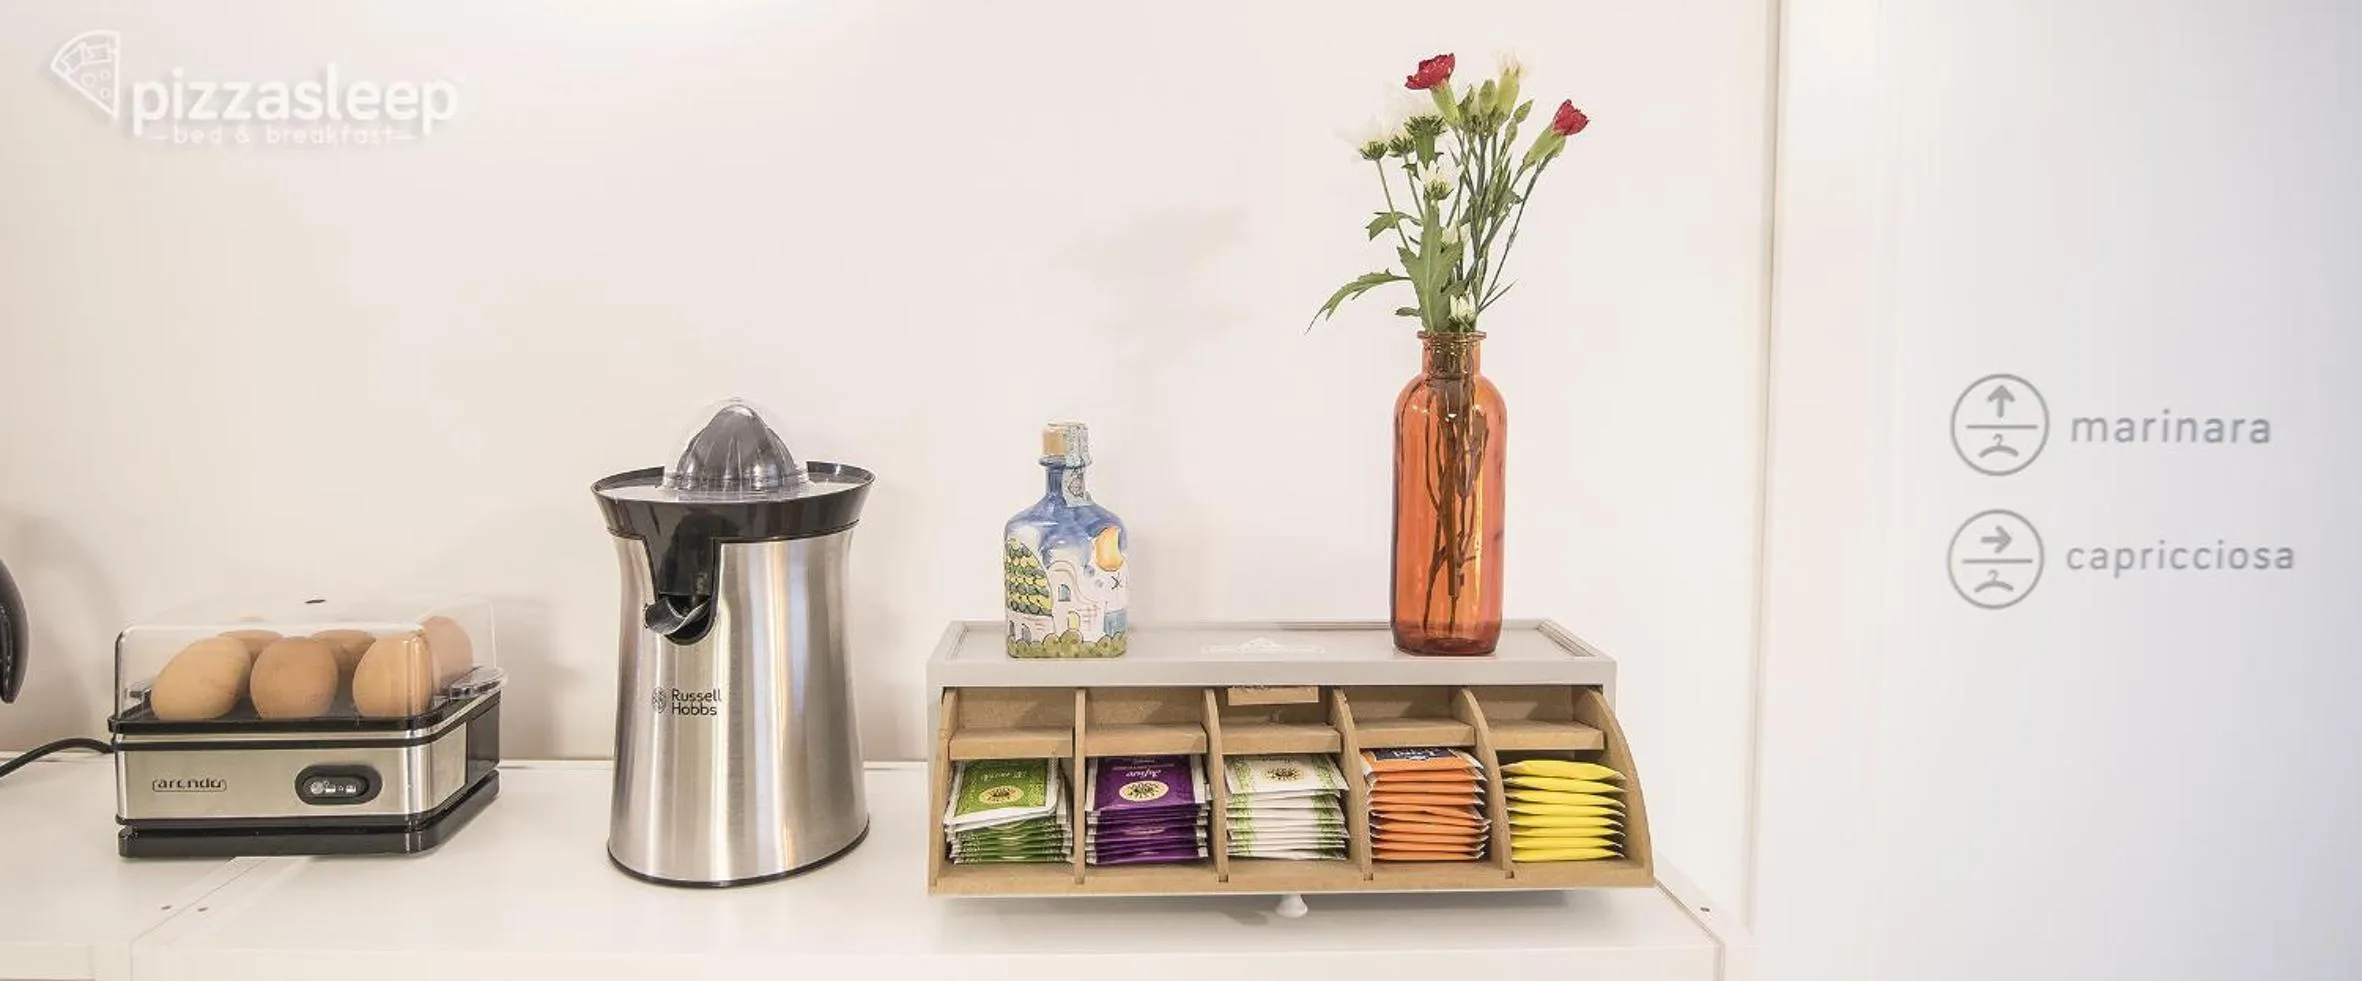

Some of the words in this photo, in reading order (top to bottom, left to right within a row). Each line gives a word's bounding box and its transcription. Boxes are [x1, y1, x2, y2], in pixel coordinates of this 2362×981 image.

[2071, 408, 2271, 444] marinara
[2066, 539, 2296, 578] capricciosa
[671, 688, 722, 702] Russell
[671, 702, 718, 716] Hobbs
